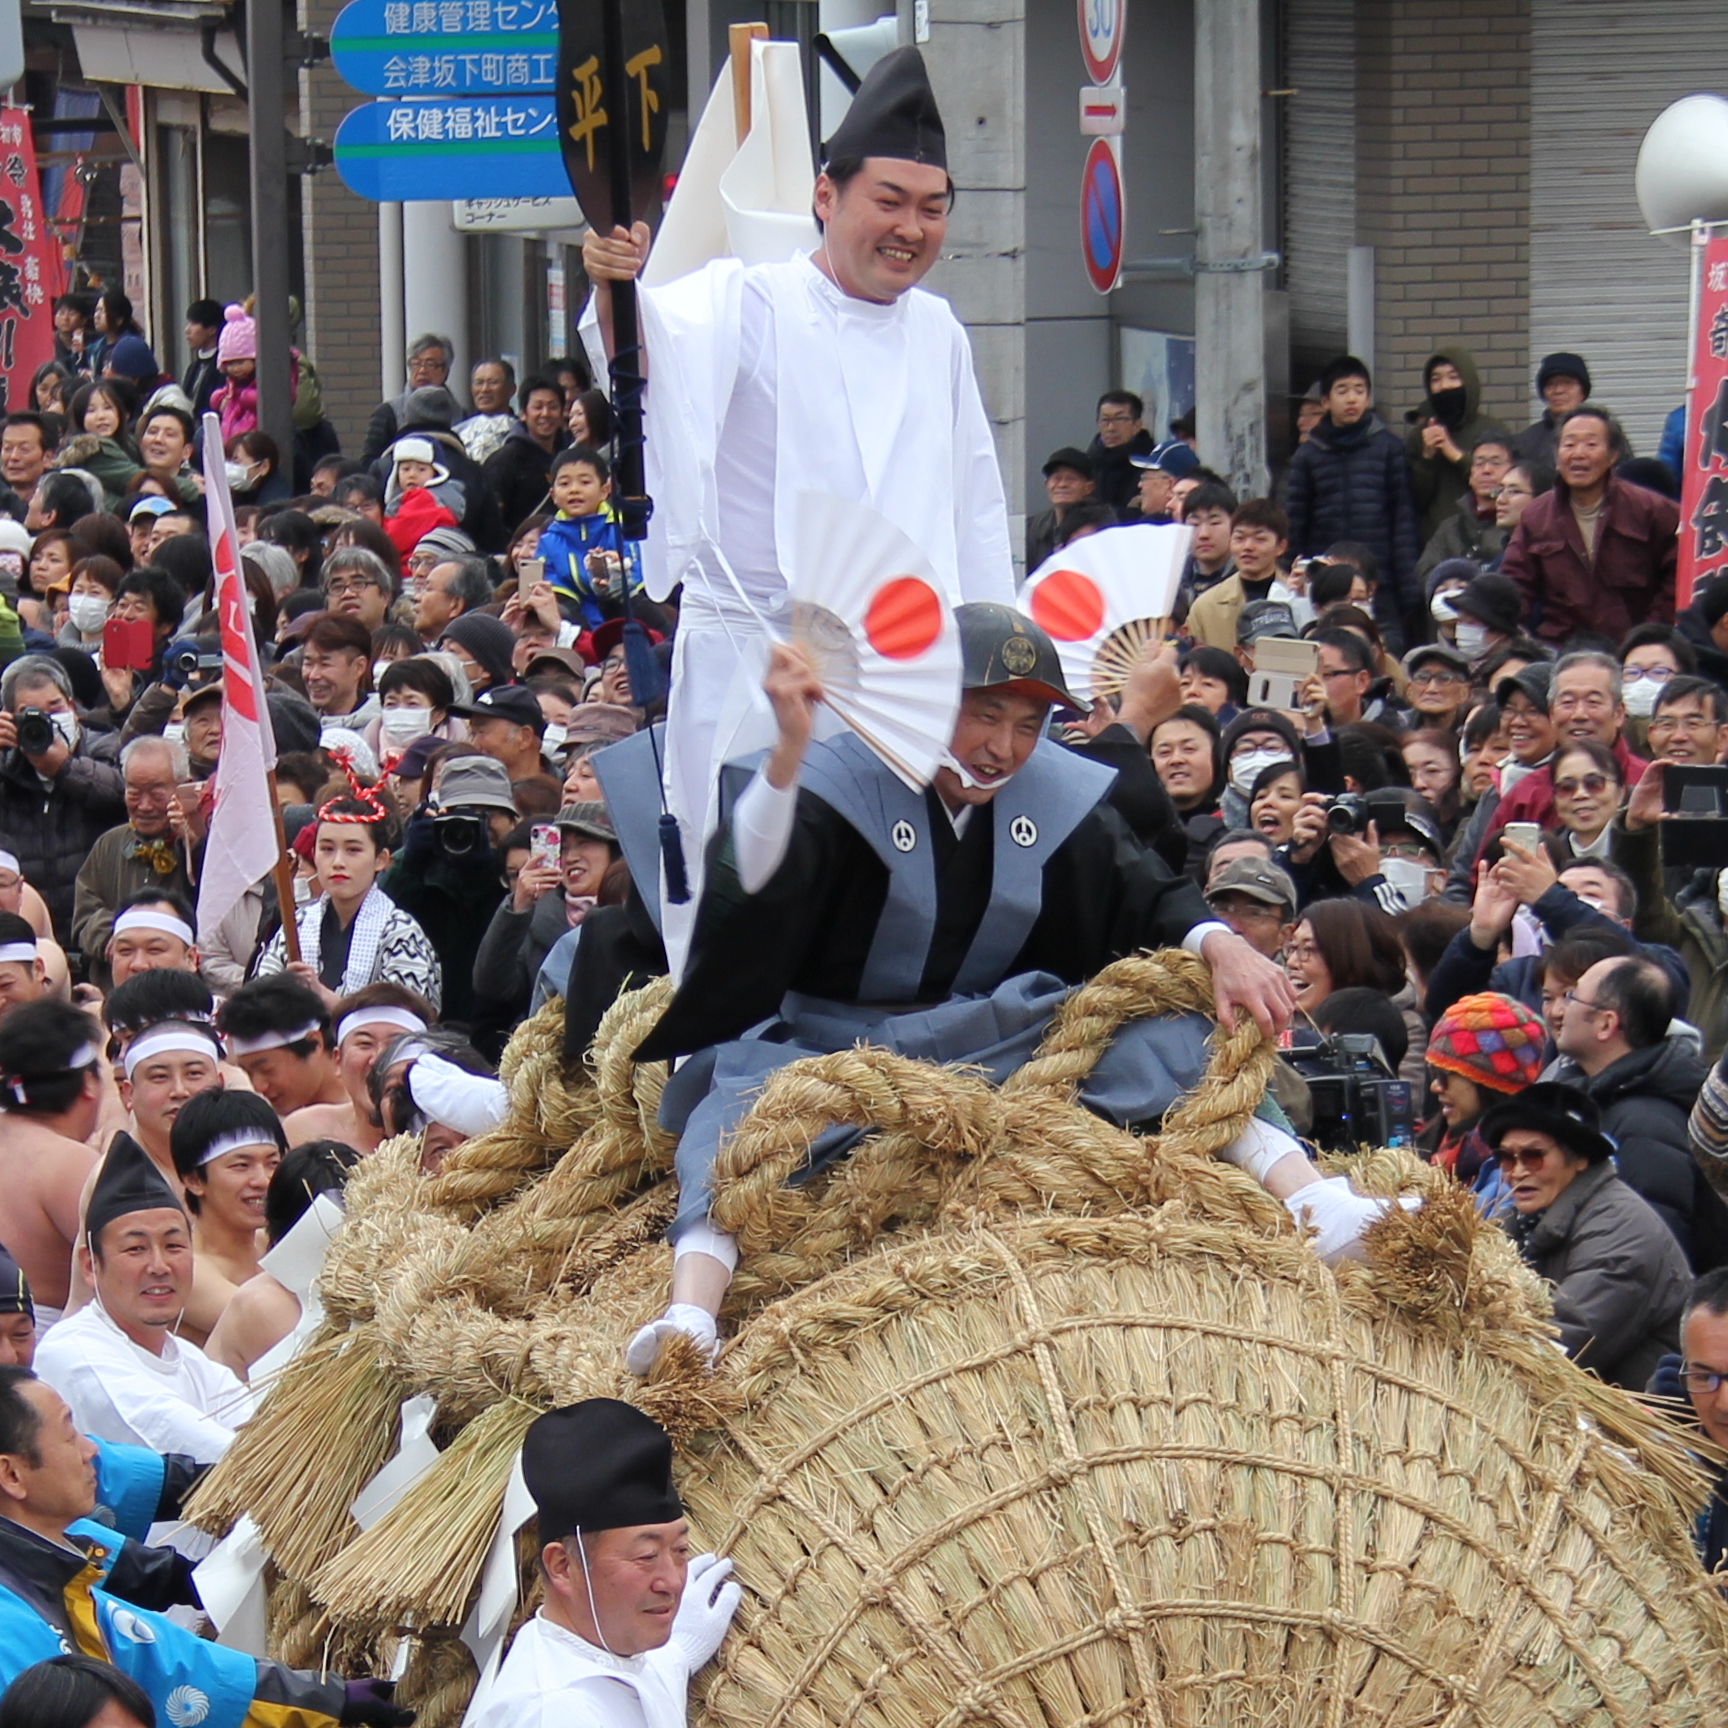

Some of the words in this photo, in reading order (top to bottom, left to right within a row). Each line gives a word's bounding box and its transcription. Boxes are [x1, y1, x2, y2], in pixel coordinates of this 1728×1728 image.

[386, 107, 559, 141] 保健福祉セン
[569, 55, 608, 173] 平
[625, 45, 662, 152] 下
